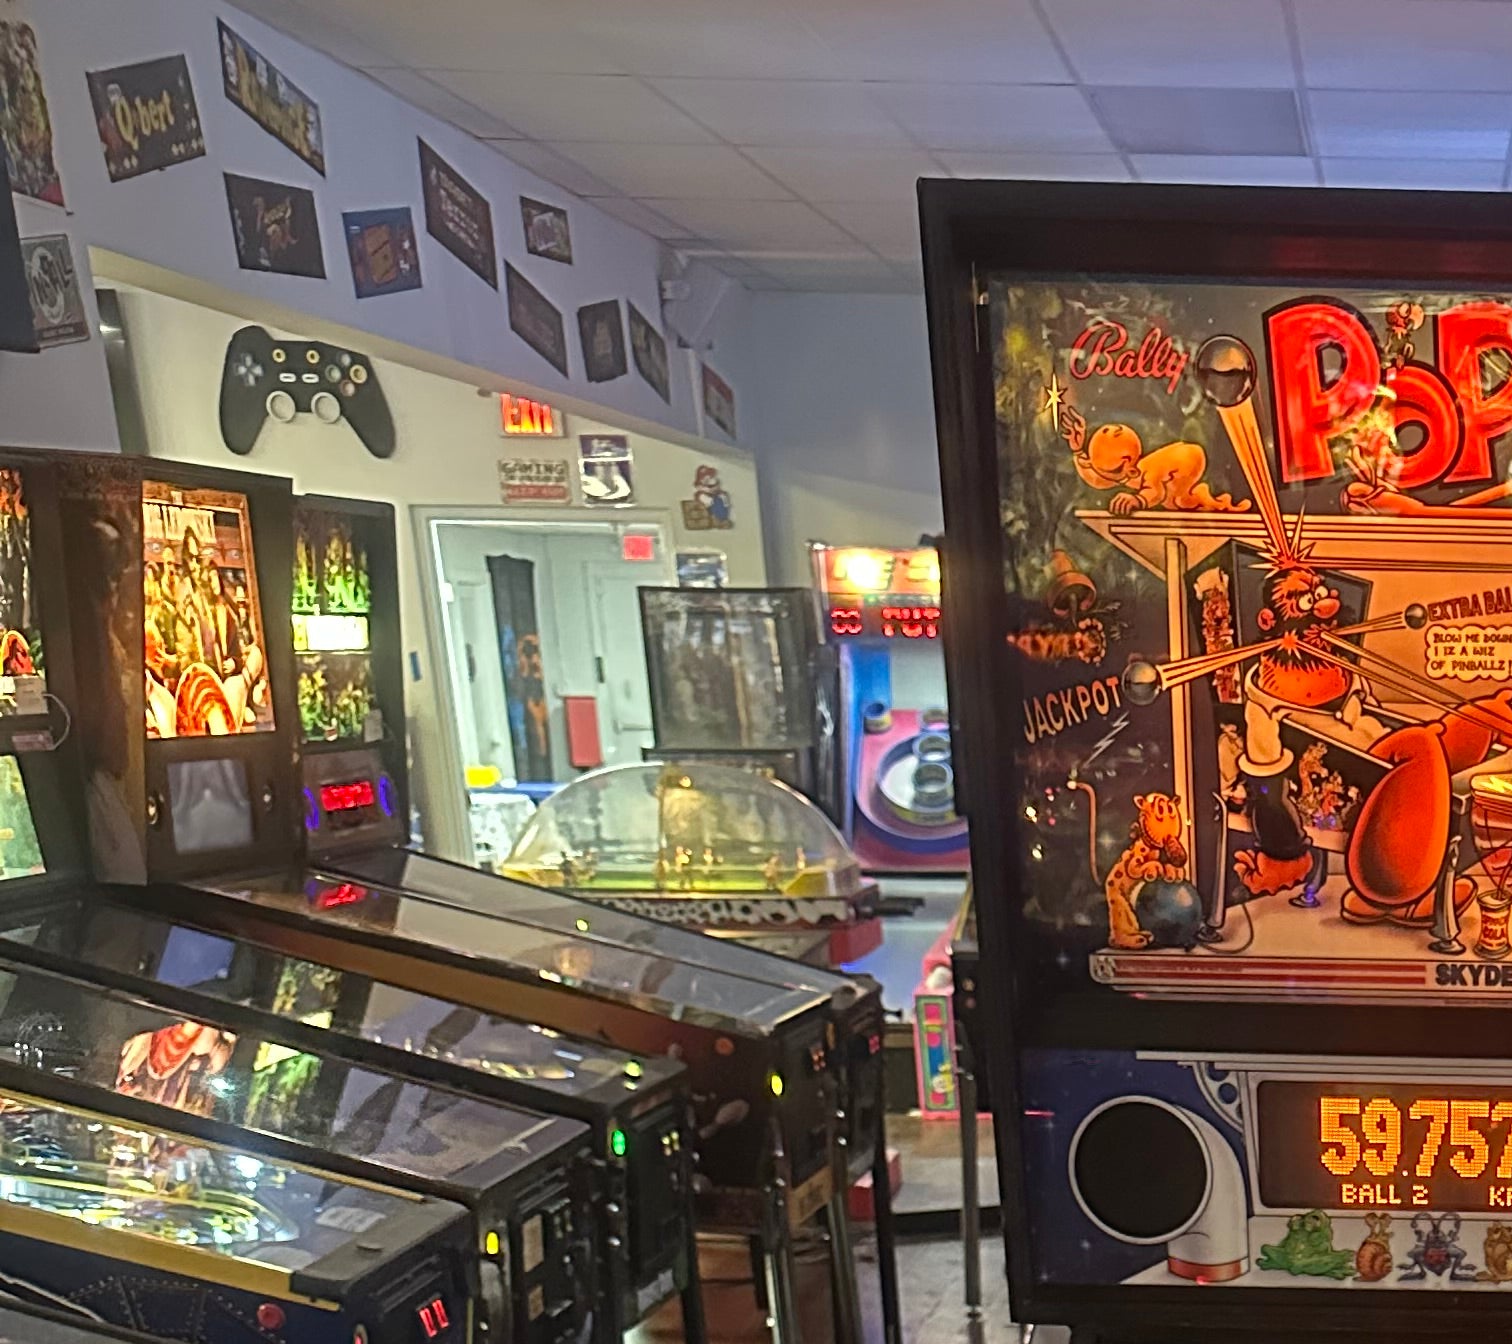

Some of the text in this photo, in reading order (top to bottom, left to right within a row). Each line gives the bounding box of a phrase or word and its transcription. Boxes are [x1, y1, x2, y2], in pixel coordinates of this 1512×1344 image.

[1069, 319, 1191, 394] Bally
[1427, 594, 1483, 622] EXTRA
[1433, 633, 1512, 643] BLOW ME DOWN
[1460, 646, 1468, 656] A
[1430, 661, 1446, 671] OF
[1023, 676, 1121, 744] JACKPOT
[1342, 1183, 1429, 1205] BALL 2
